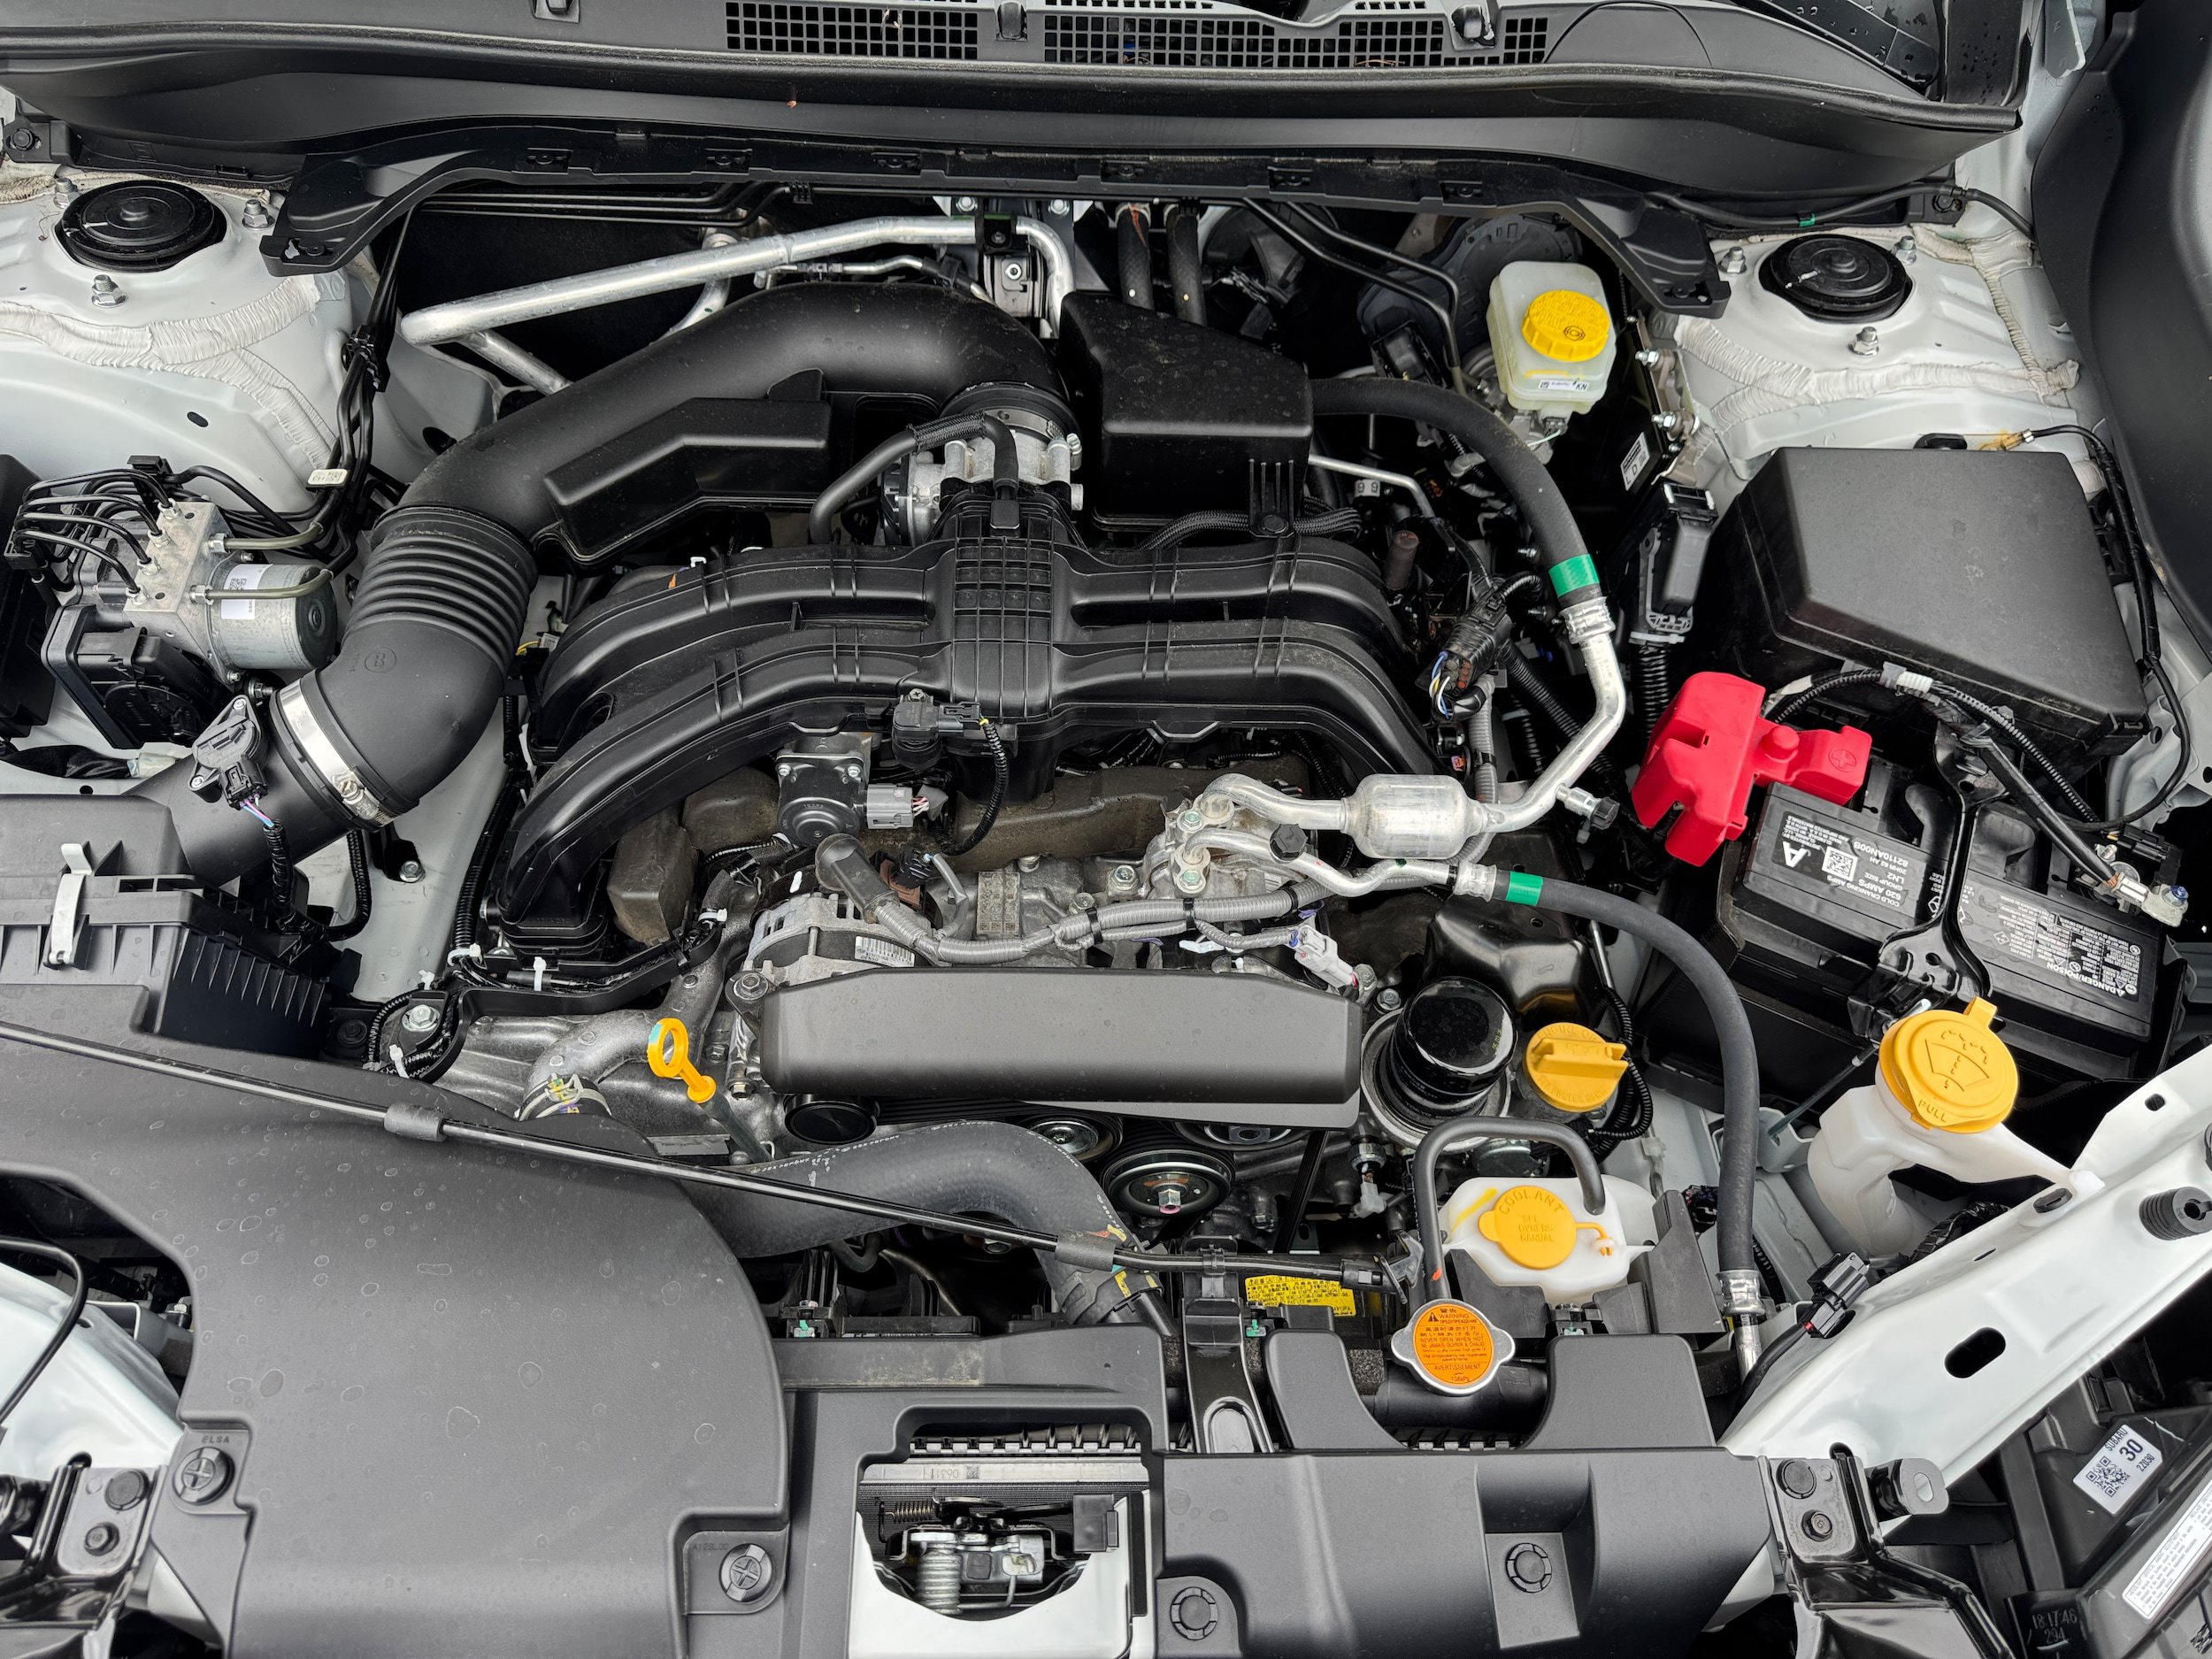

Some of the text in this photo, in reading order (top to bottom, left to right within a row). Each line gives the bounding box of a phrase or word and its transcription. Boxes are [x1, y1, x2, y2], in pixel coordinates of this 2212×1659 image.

[1782, 841, 1809, 869] A
[1853, 840, 1909, 867] 82110AN00B
[1869, 856, 1879, 864] AH
[1886, 871, 1904, 884] LN2
[1888, 863, 1906, 874] 20HR
[1825, 873, 1900, 907] COLD CRANKING AMPS
[1857, 878, 1901, 901] 620 AMPS
[1863, 871, 1902, 891] GROUP SIZE
[2045, 962, 2116, 994] DANGER/POISON
[1537, 1025, 1577, 1039] ENGINE
[1918, 1099, 1947, 1123] PULL
[1499, 1189, 1564, 1215] COOLANT
[1520, 1233, 1555, 1242] MANUAL
[2103, 1426, 2128, 1451] SUBARU
[2117, 1437, 2144, 1462] 30
[2135, 1452, 2154, 1472] 2Z030
